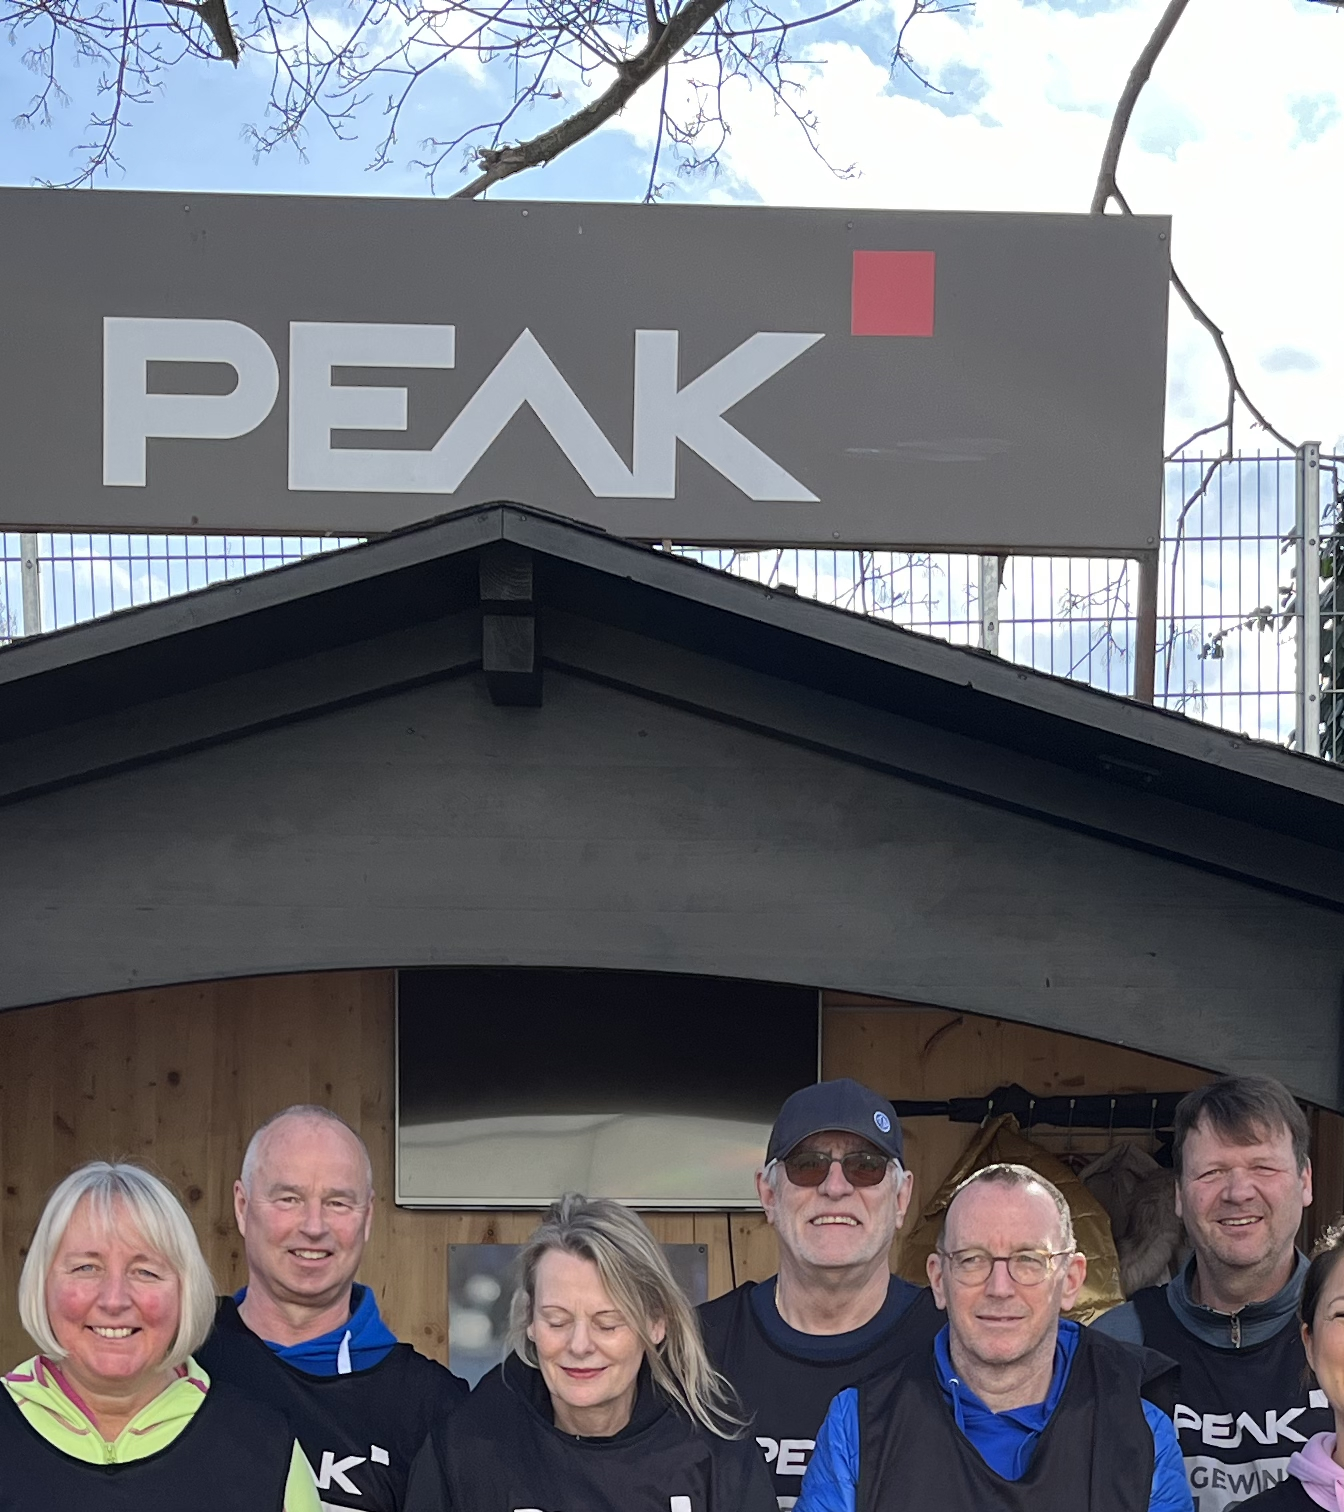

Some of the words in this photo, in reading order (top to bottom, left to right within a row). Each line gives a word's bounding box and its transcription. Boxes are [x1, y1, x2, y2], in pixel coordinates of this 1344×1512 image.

[103, 316, 826, 502] PEAK
[1173, 1403, 1309, 1449] PEAK
[755, 1436, 817, 1476] PE
[1190, 1465, 1284, 1495] GEWIN
